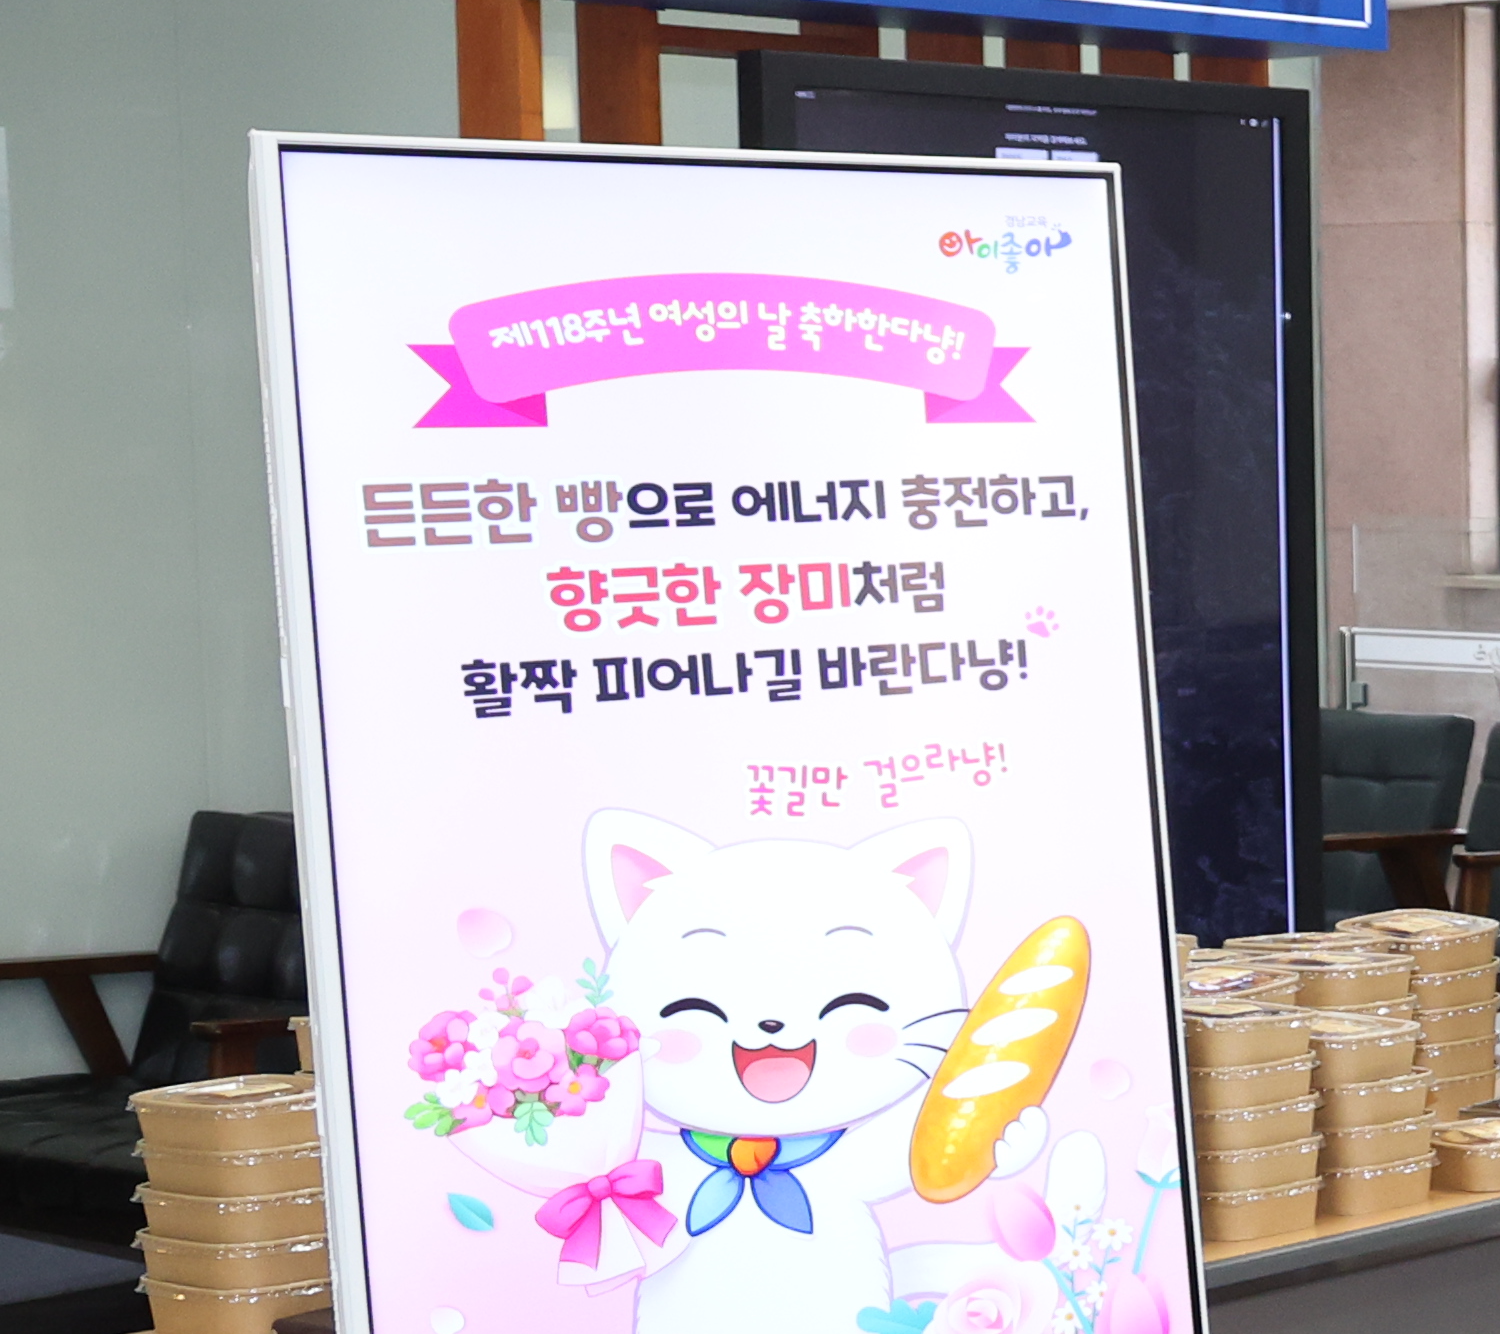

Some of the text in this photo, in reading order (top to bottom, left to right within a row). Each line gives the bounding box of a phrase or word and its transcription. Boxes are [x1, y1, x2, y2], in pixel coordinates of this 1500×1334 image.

[489, 300, 965, 365] 제118주년 여성의 날 축하한다냥!
[363, 474, 1088, 547] 든든한 빵으로 에너지 충전하고,
[547, 561, 944, 632] 향긋한 장미처럼
[461, 639, 1027, 719] 활짝 피어나길 바란다냥!
[747, 742, 1007, 816] 꽃길만 걸으라냥!
